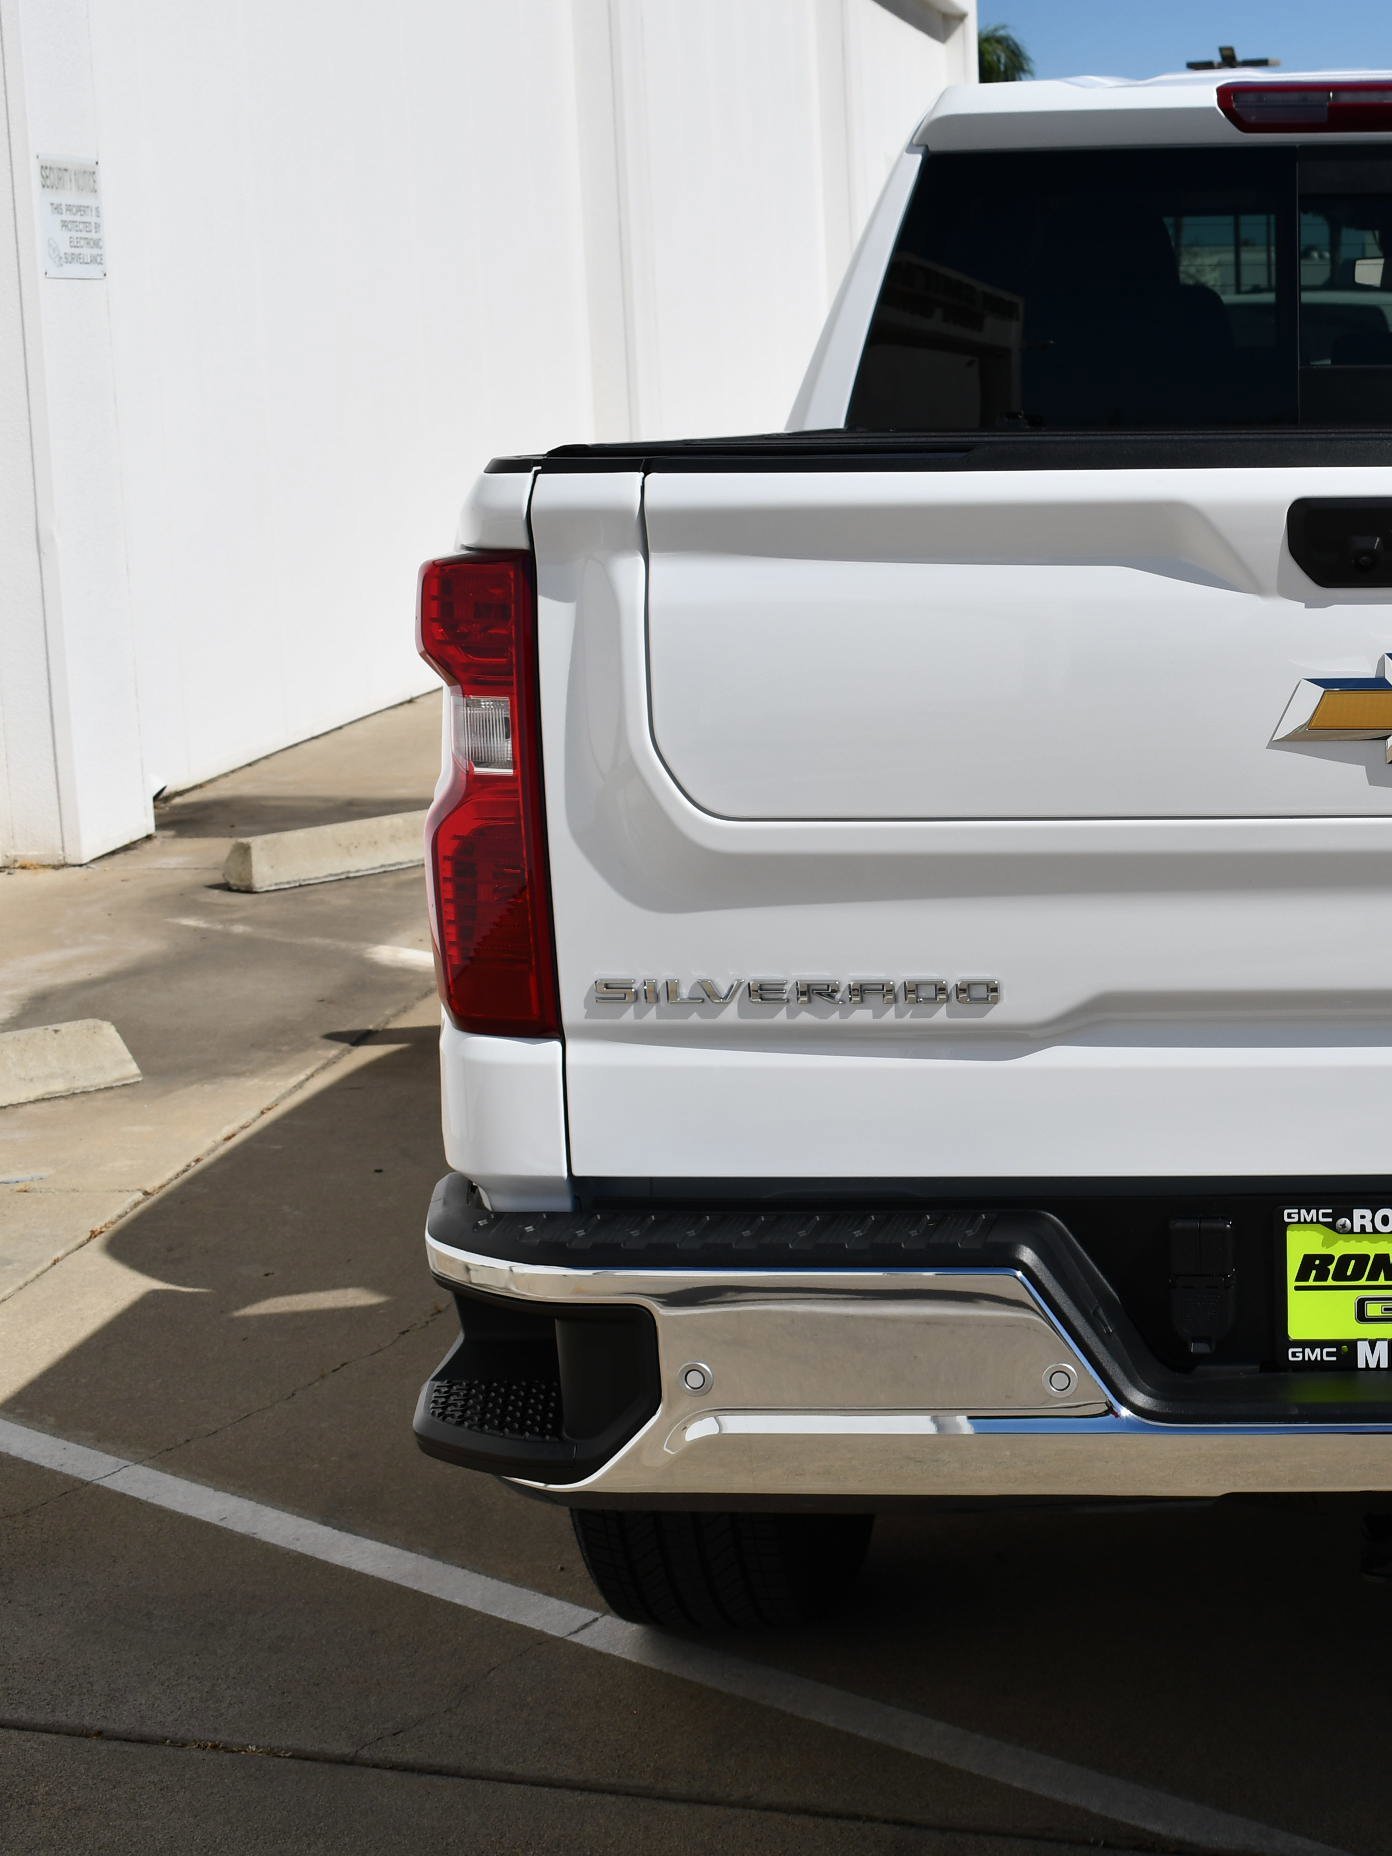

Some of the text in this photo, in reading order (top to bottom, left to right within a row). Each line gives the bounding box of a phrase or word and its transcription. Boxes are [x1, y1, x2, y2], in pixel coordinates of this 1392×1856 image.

[63, 251, 104, 266] SURVEILLANCE
[594, 978, 1001, 1006] SILVERADO
[1283, 1208, 1333, 1223] GMC
[1288, 1347, 1337, 1362] GMC
